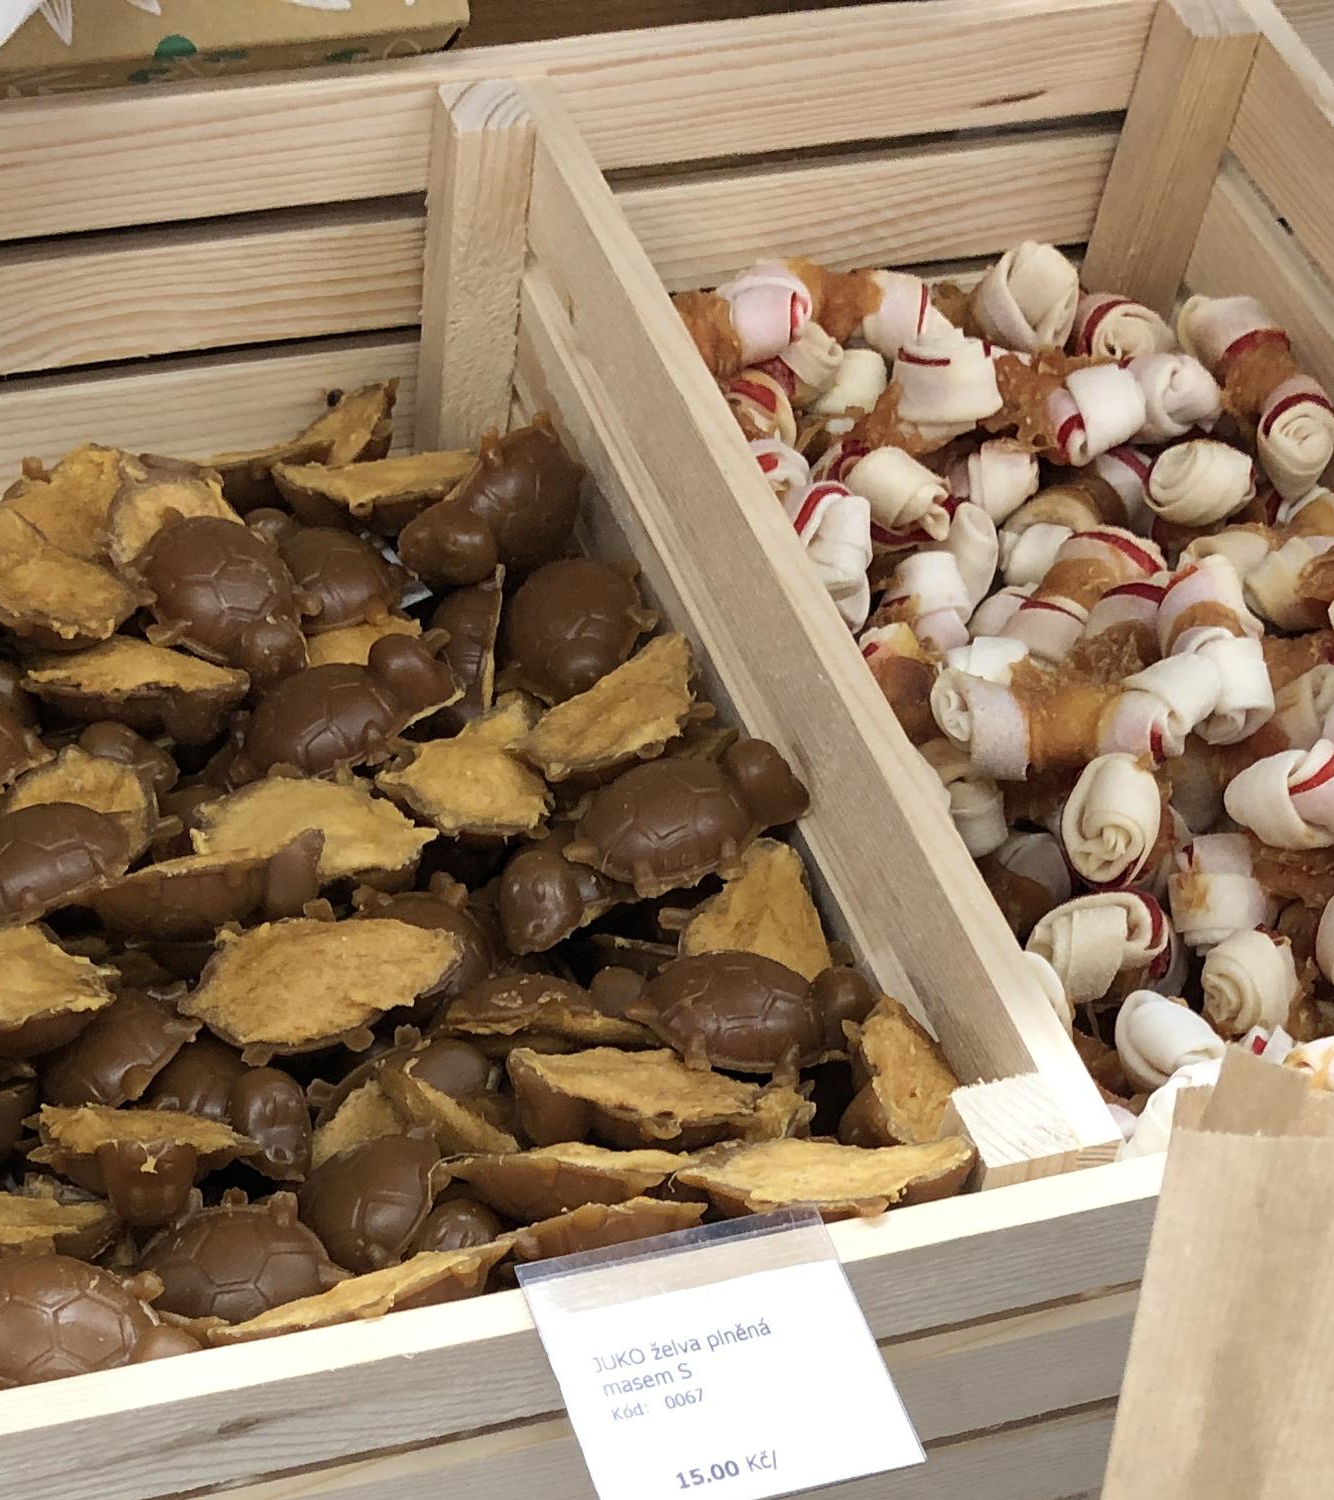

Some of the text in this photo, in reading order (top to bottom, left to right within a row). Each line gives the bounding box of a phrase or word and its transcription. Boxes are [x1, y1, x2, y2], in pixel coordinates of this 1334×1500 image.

[592, 1316, 772, 1374] JUKO želva plněná
[602, 1362, 693, 1398] masem S
[610, 1387, 704, 1421] Kód: 0067
[675, 1459, 740, 1490] 15.00
